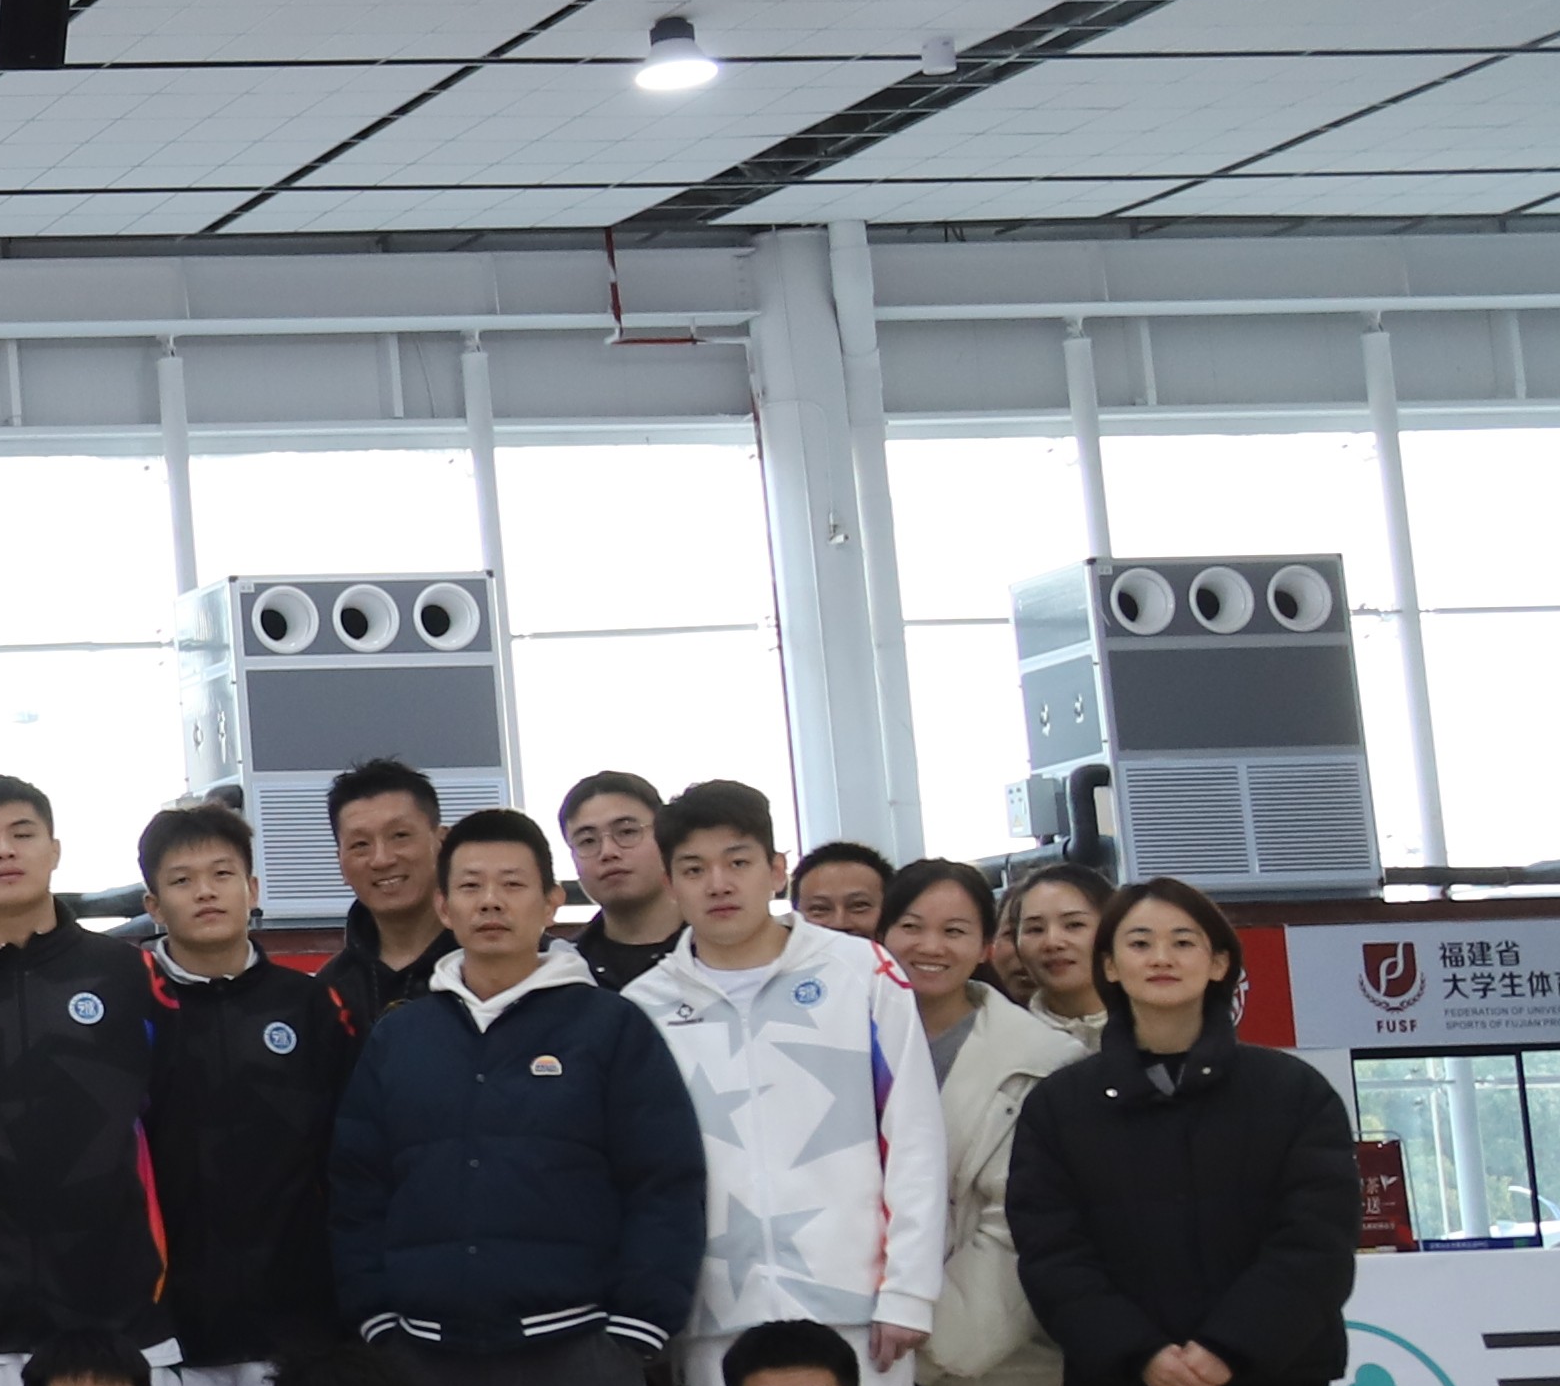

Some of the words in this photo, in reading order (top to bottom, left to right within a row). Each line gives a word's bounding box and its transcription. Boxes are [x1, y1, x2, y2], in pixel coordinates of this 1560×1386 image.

[1439, 940, 1521, 968] 福建省
[1376, 1019, 1418, 1033] FUSF
